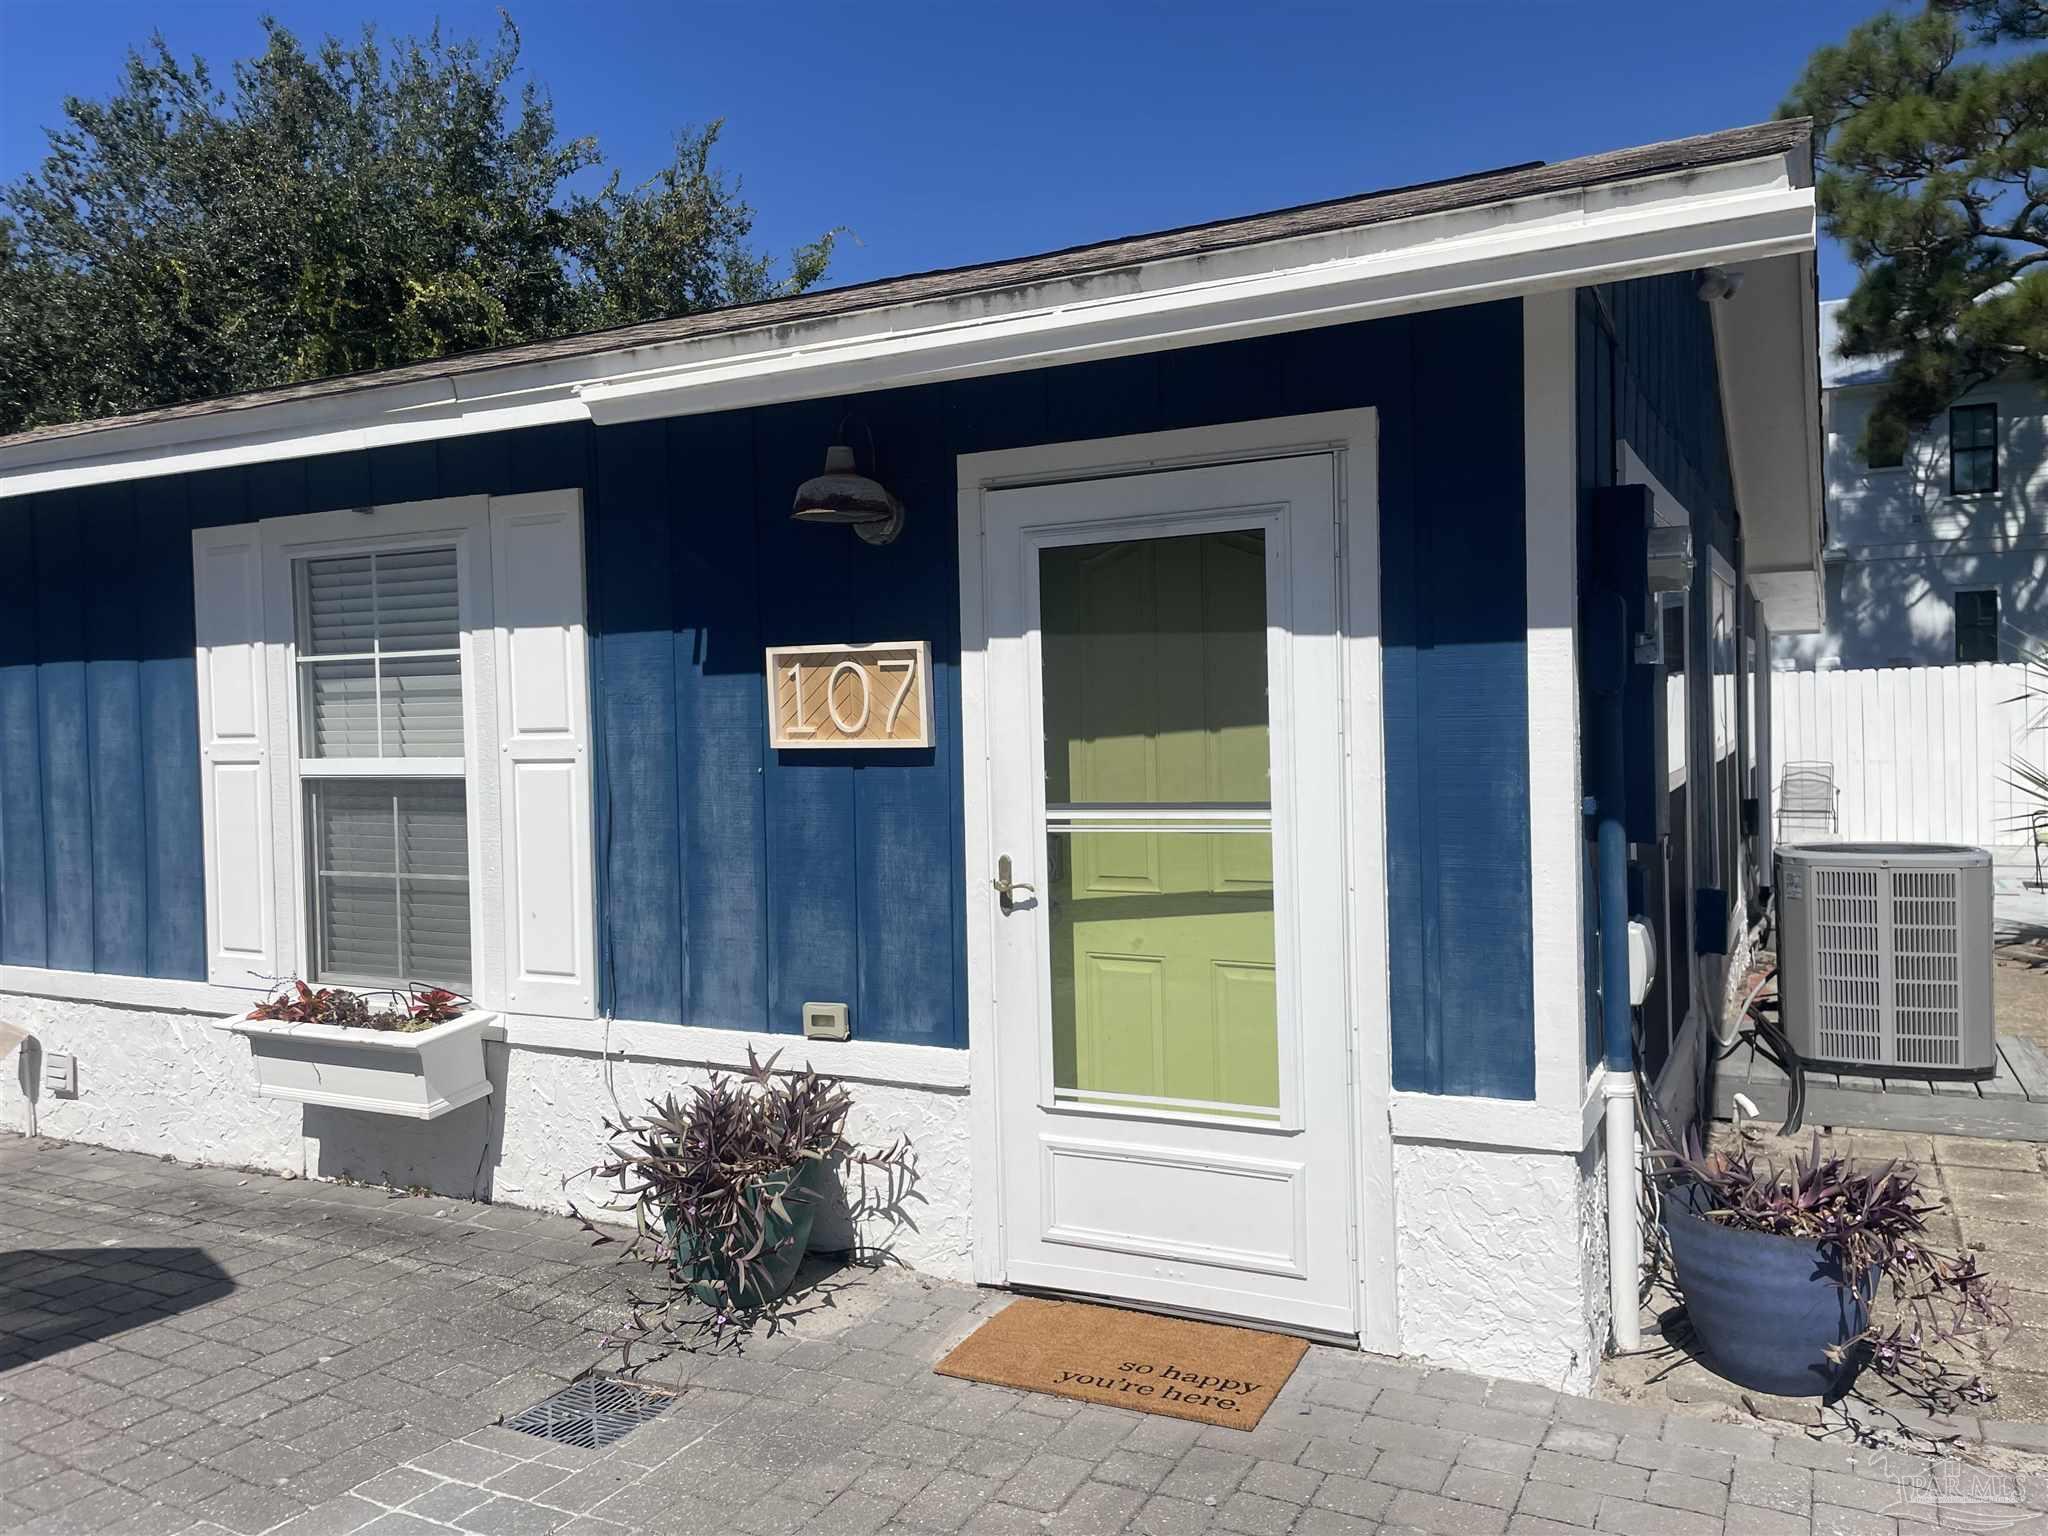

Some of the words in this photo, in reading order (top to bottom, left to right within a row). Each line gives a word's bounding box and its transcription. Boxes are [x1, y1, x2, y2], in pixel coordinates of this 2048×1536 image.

[786, 660, 915, 734] 107
[1053, 1371, 1154, 1396] you're
[1162, 1386, 1241, 1412] here.
[1118, 1360, 1154, 1375] so
[1159, 1364, 1262, 1396] happy
